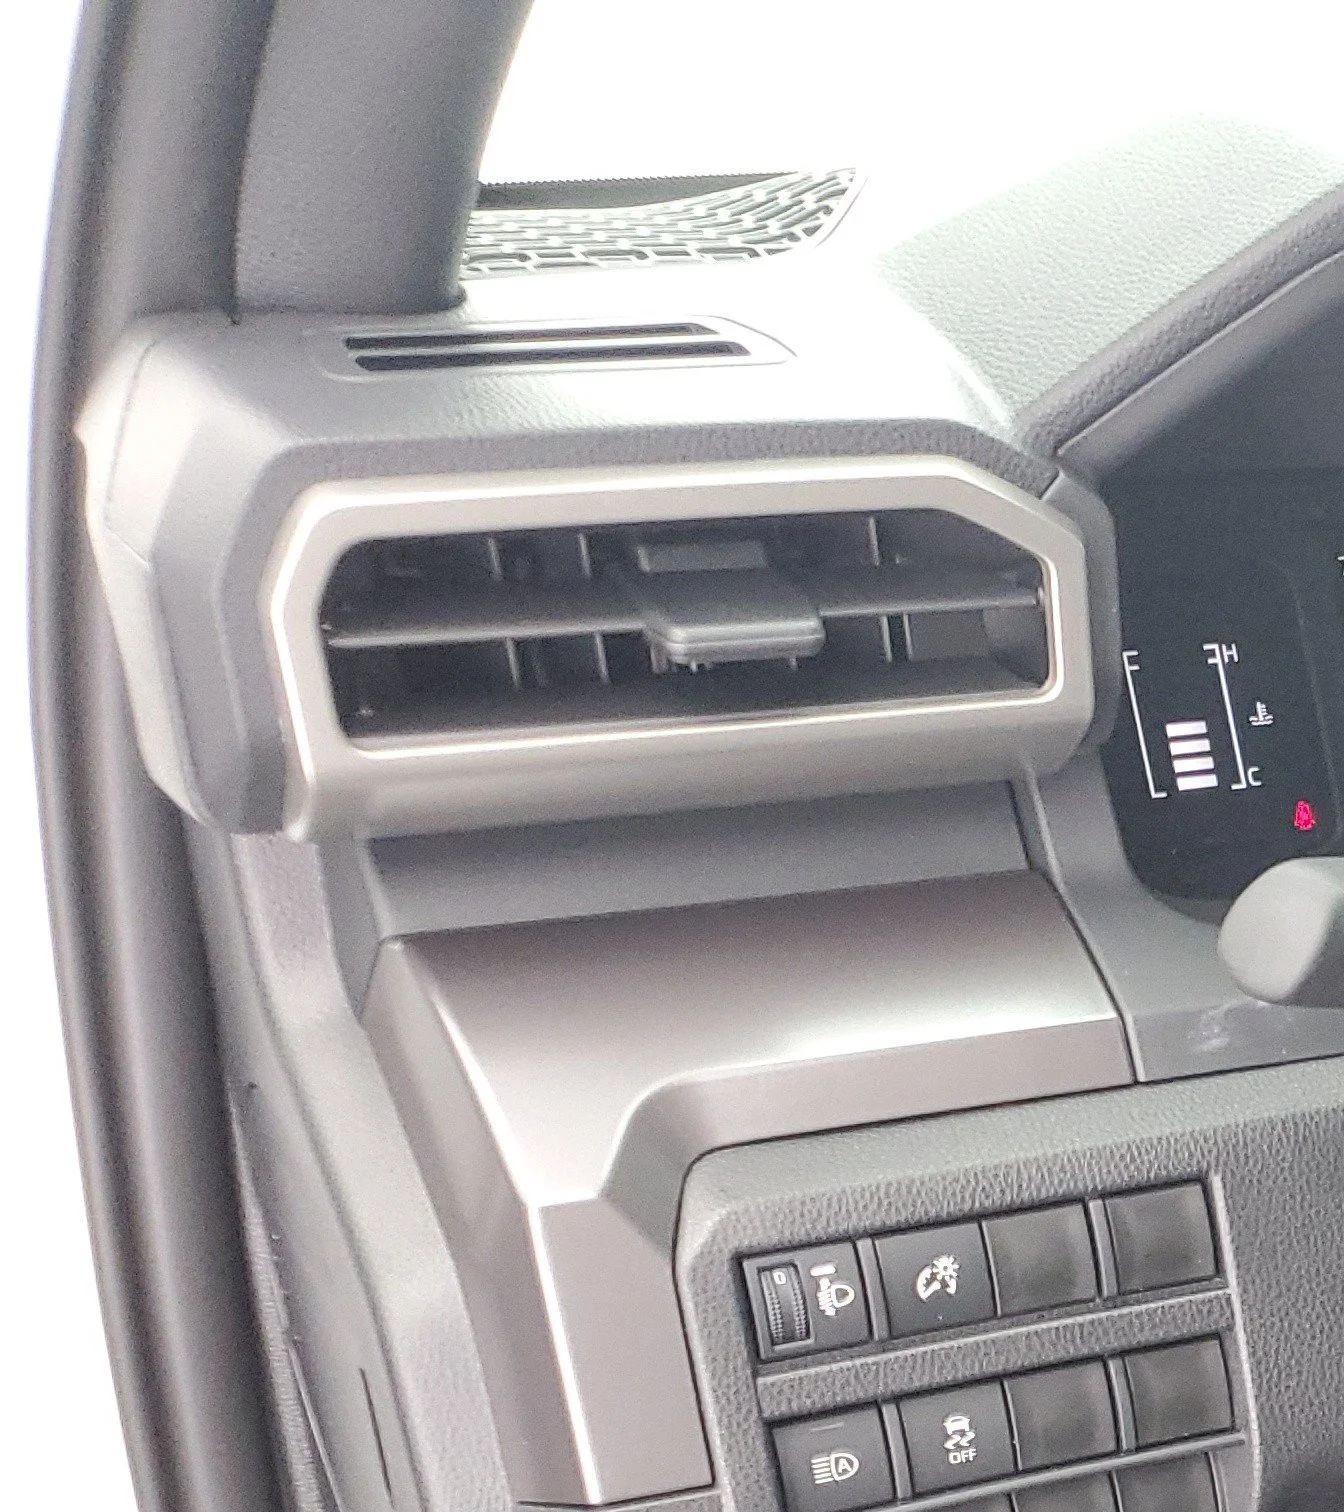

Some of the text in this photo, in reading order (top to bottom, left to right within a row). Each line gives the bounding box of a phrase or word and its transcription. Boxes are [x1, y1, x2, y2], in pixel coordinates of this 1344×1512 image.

[1222, 643, 1239, 663] H
[1248, 766, 1262, 787] C
[948, 1447, 978, 1465] OFF
